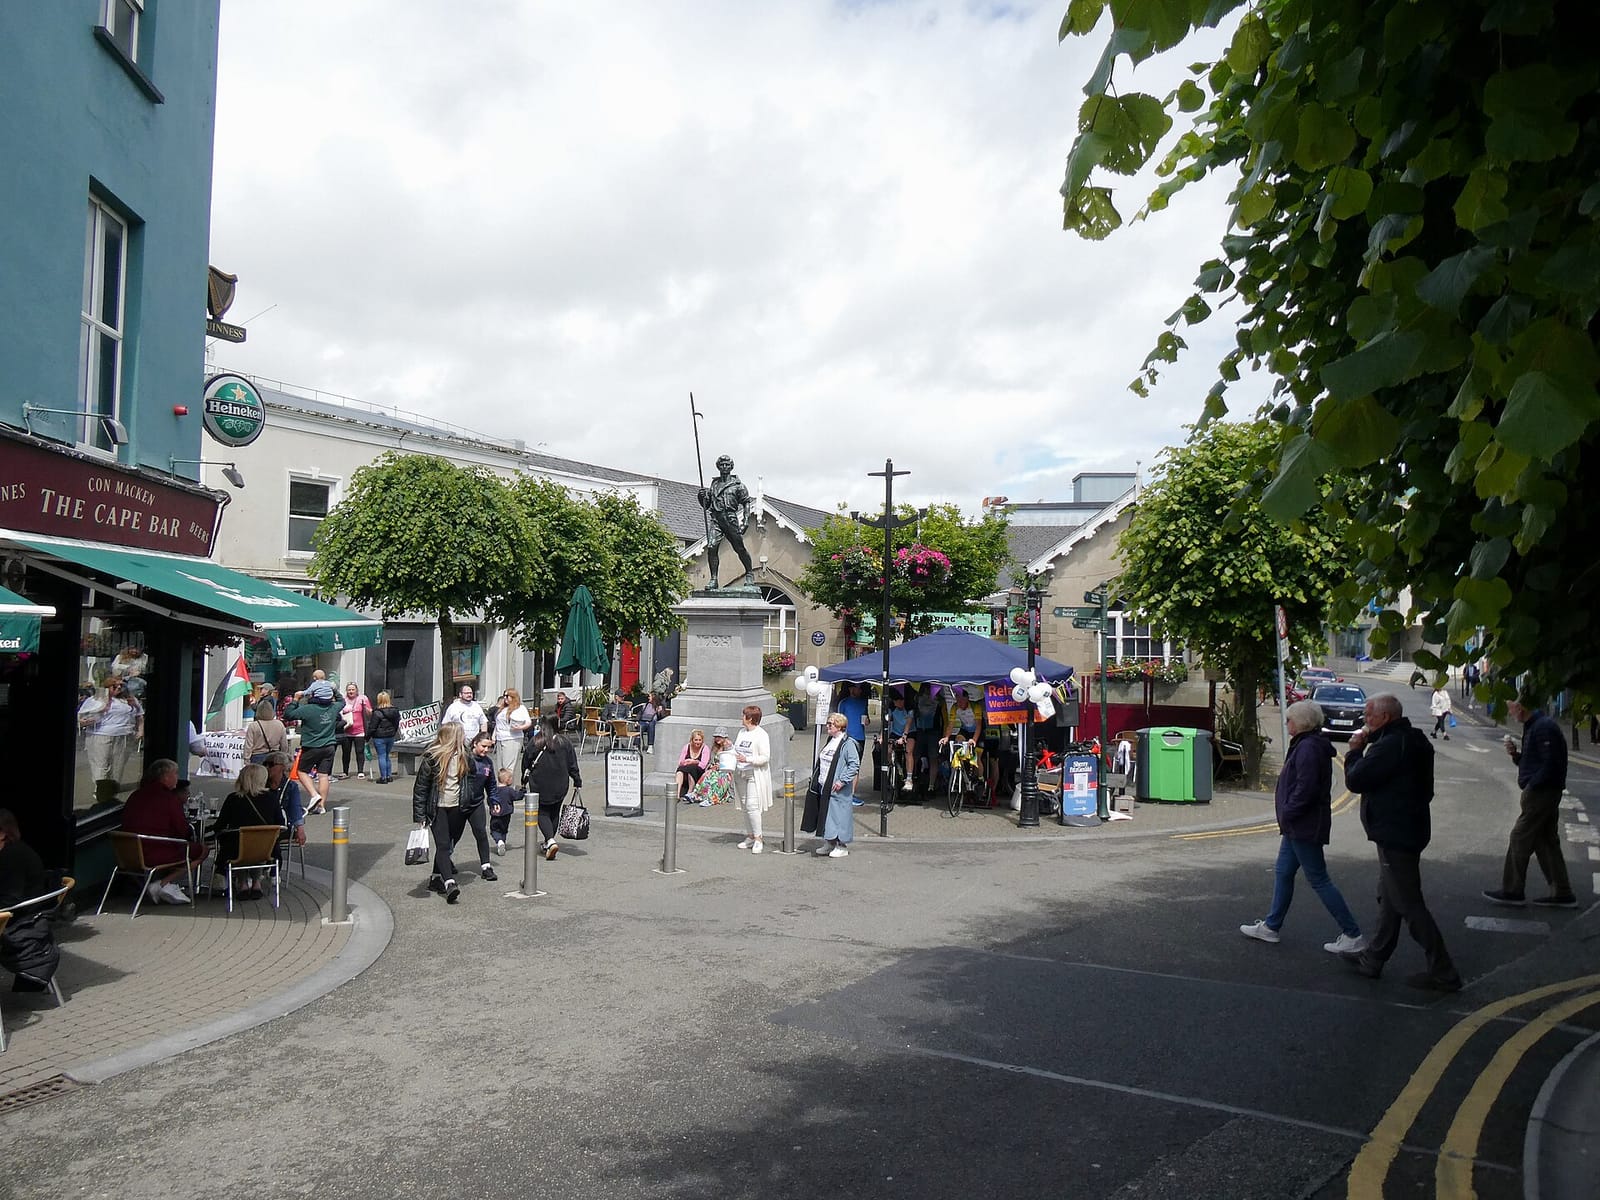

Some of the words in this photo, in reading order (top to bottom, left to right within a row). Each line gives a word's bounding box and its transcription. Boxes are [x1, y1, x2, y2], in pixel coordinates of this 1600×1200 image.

[209, 401, 262, 421] Heineken
[88, 477, 111, 492] CON
[114, 481, 156, 507] MACKEN
[40, 488, 86, 519] THE
[94, 503, 142, 530] CAPE
[149, 515, 181, 538] BAR
[189, 521, 210, 544] BEERS
[696, 634, 733, 648] 798
